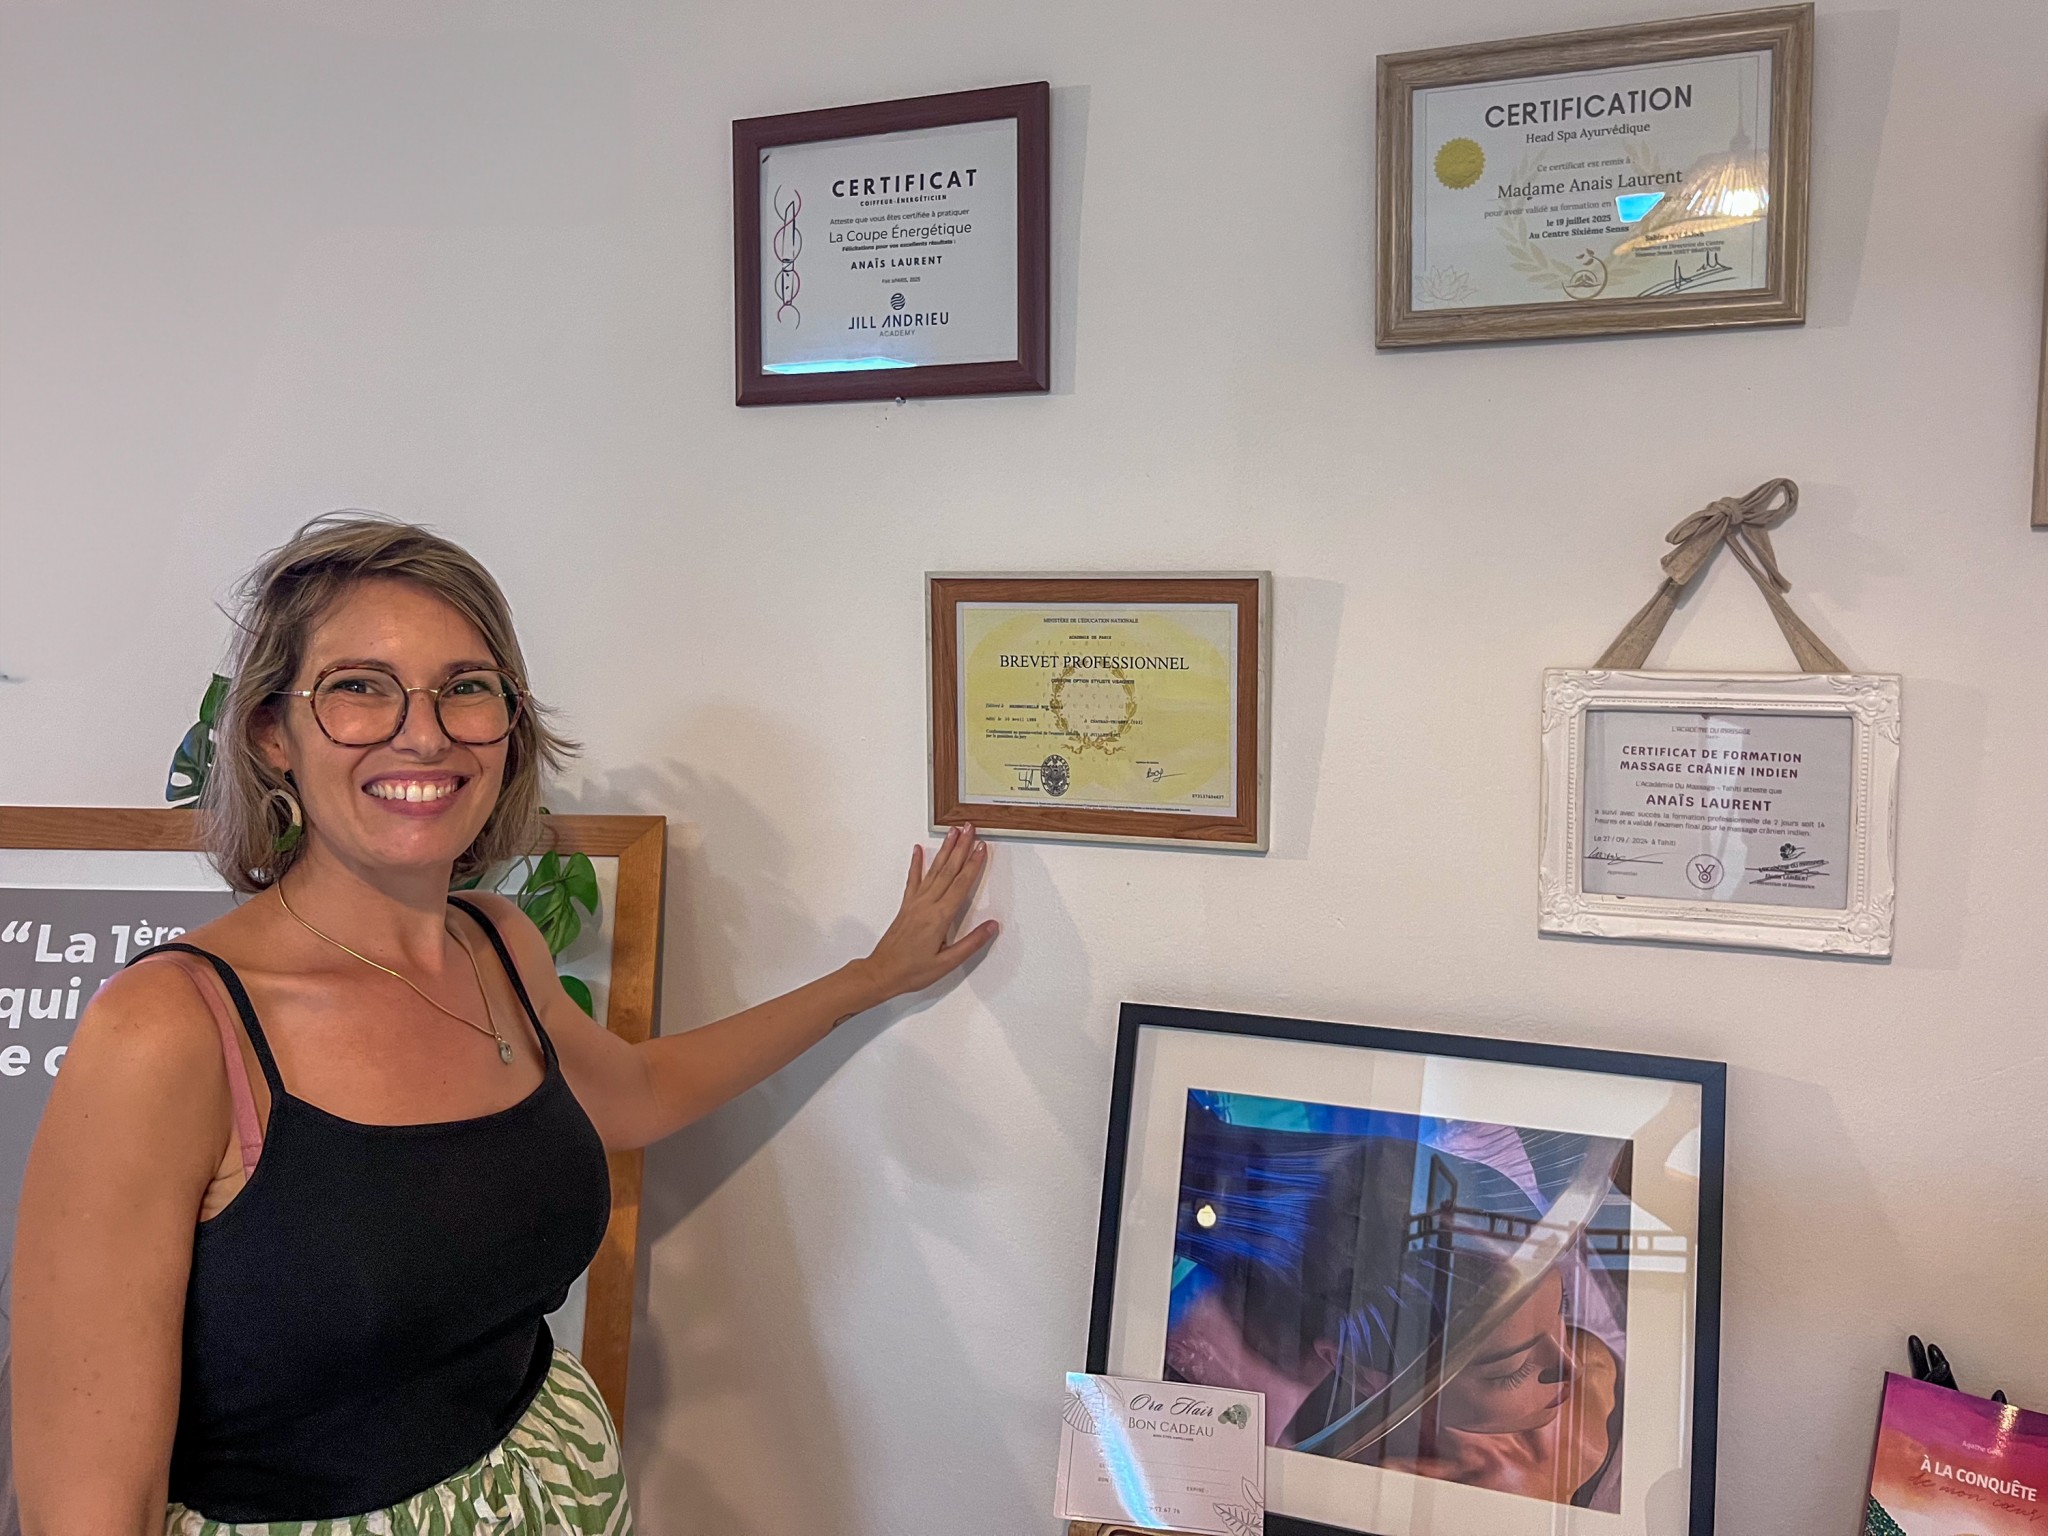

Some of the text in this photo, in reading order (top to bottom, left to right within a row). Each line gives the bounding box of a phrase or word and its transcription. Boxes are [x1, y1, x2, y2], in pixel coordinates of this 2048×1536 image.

[1484, 84, 1692, 128] CERTIFICATION
[1526, 122, 1650, 144] Head Spa Ayurvédique
[1537, 156, 1631, 172] Ce certificat est remis à
[832, 169, 977, 198] CERTIFICAT
[1498, 182, 1565, 200] Madame
[1618, 170, 1683, 188] Laurent
[830, 217, 854, 225] Atteste
[855, 216, 868, 224] que
[902, 211, 930, 220] certifiée
[932, 210, 936, 218] à
[937, 208, 970, 218] pratiquer
[1484, 210, 1502, 219] pour
[1504, 207, 1523, 216] avoir
[1560, 201, 1600, 212] formation
[1546, 214, 1612, 227] le 19 juillet 2025
[830, 222, 972, 243] La Coupe Énergétique
[1528, 231, 1540, 240] Au
[1542, 229, 1570, 239] Centre
[1571, 226, 1604, 236] Sixième
[900, 240, 928, 248] excellents
[850, 256, 942, 270] ANAÏS LAURENT
[848, 312, 949, 330] JILL ANDRIEU
[1000, 655, 1190, 670] BREVET PROFESSIONNEL
[1622, 746, 1802, 764] CERTIFICAT DE FORMATION
[1620, 760, 1798, 779] MASSAGE CRÂNIEN INDIEN
[1675, 782, 1684, 790] Du
[1686, 783, 1716, 792] Massage
[1722, 784, 1742, 793] Tahiti
[1743, 786, 1768, 794] atteste
[1768, 788, 1783, 796] que
[1646, 794, 1772, 812] ANAÏS LAURENT
[1654, 820, 1684, 828] l'examen
[1726, 826, 1757, 834] massage
[1759, 827, 1785, 835] crânien
[1708, 816, 1760, 825] professionnelle
[0, 976, 82, 1029] qui
[1129, 1393, 1216, 1416] Ora Hair
[1128, 1416, 1214, 1438] BON CADEAU
[1908, 1472, 1936, 1488] de
[1939, 1486, 1987, 1502] mon
[1920, 1454, 2037, 1502] À LA CONQUÊTE
